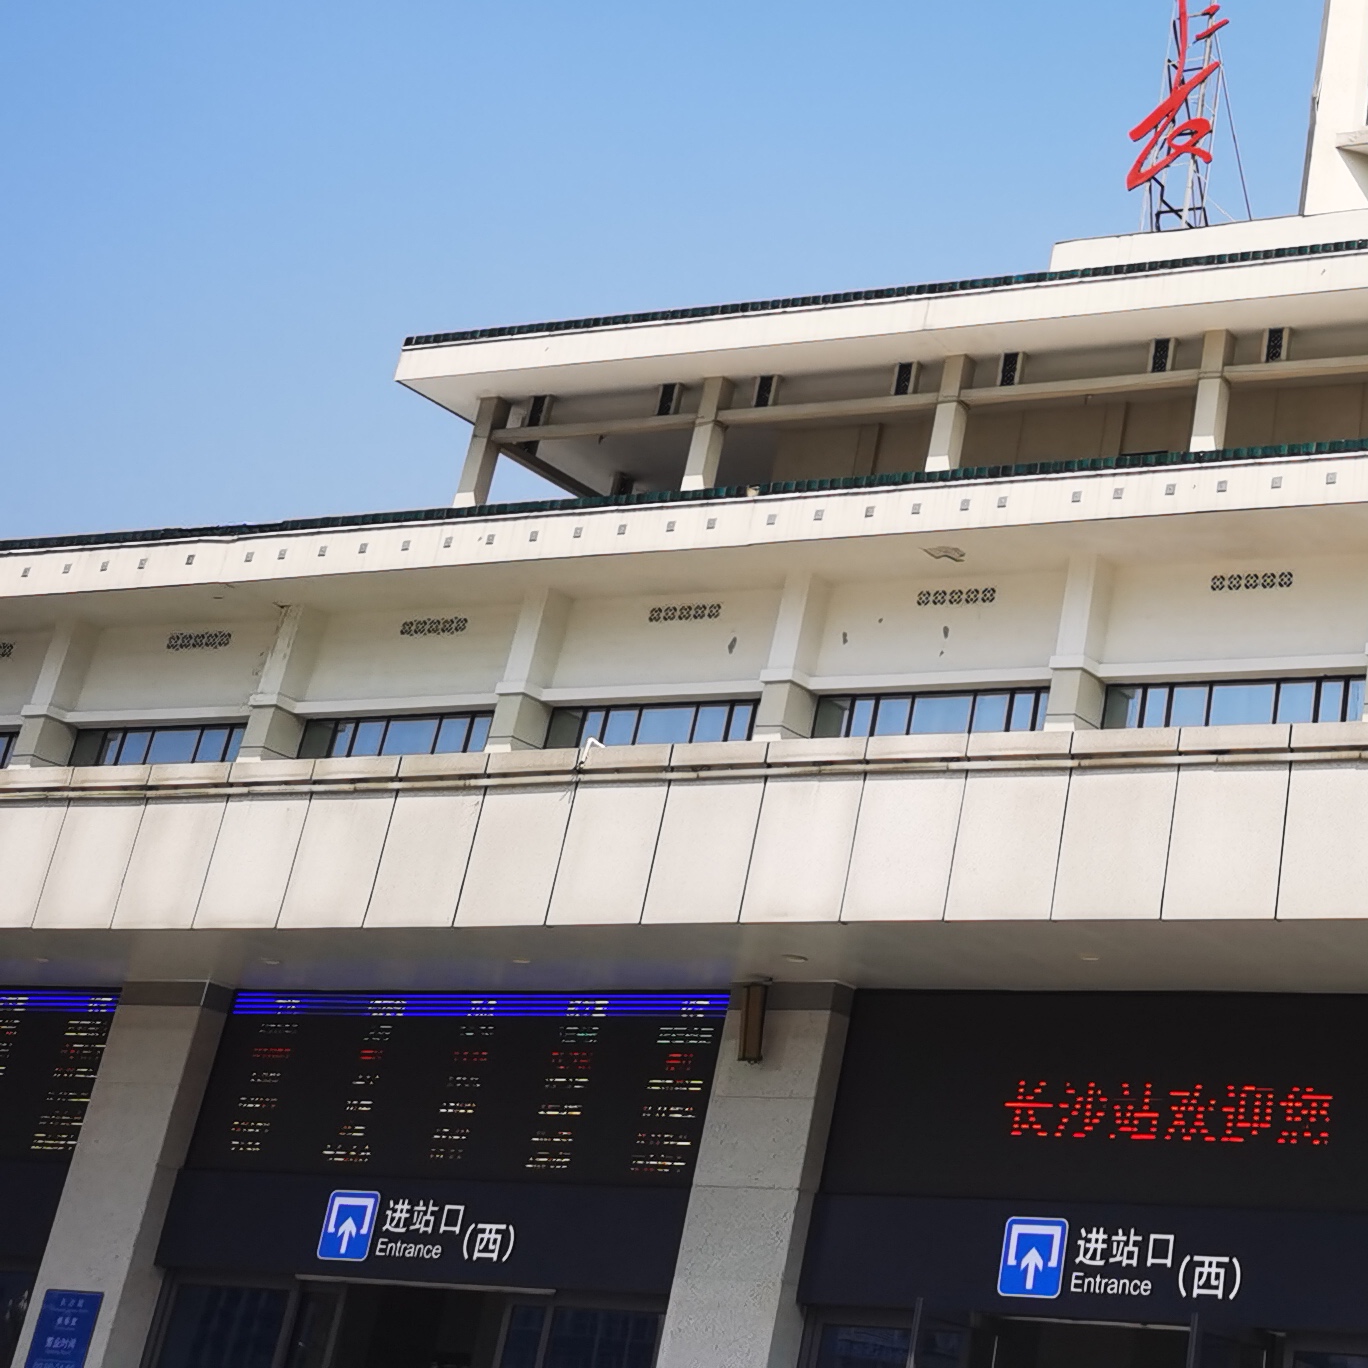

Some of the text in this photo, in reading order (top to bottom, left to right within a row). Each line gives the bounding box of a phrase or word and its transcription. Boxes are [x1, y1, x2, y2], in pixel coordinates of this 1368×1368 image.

[382, 1198, 465, 1236] 进站口
[375, 1237, 442, 1260] Entrance
[1074, 1227, 1176, 1269] 进站口
[1070, 1273, 1152, 1297] Entrance
